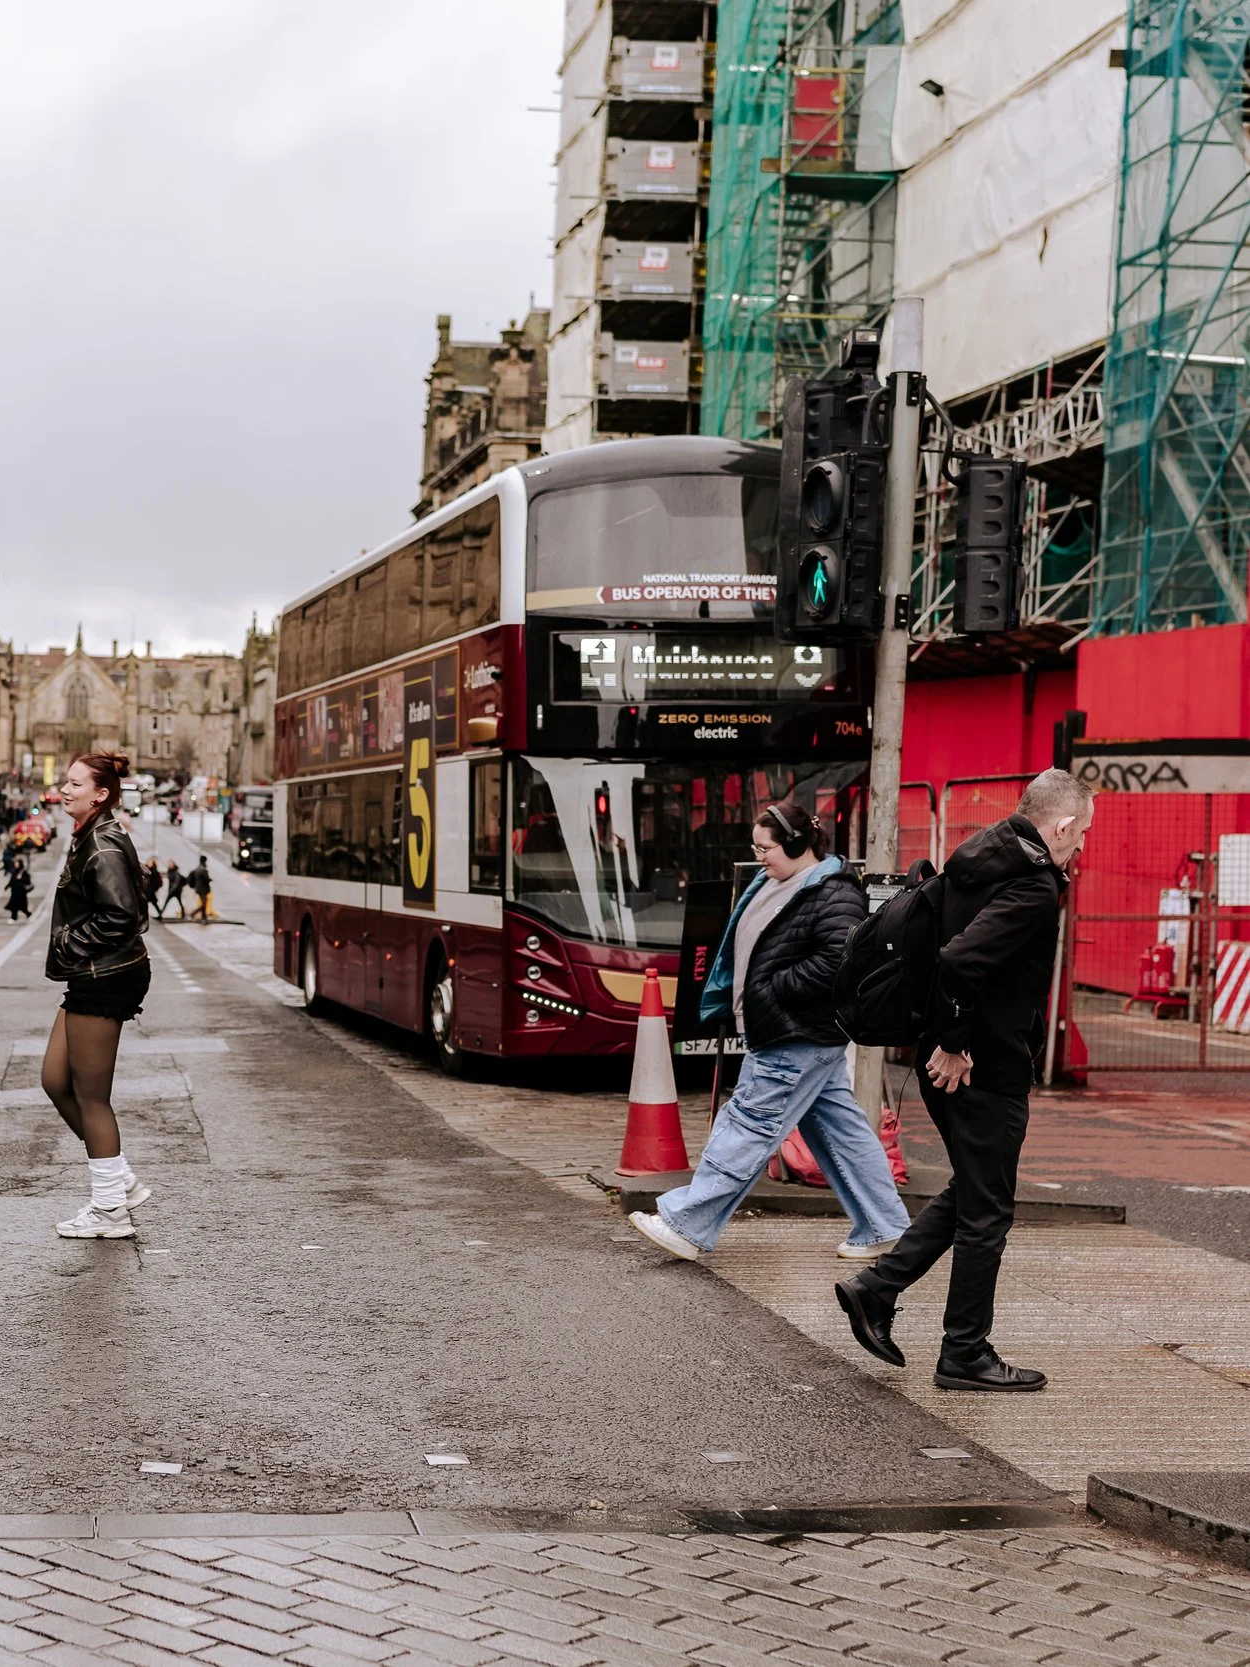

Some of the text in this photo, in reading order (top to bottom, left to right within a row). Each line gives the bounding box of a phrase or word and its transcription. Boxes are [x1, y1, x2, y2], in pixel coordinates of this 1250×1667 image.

[643, 573, 778, 585] NATIONAL TRANSPORT AWARDS
[612, 589, 642, 601] BUS
[643, 586, 720, 601] OPERATOR
[722, 586, 742, 600] OF
[743, 586, 771, 600] THE
[658, 714, 772, 724] ZERO EMISSION
[694, 726, 738, 739] electric
[835, 721, 863, 736] 704e
[408, 738, 431, 889] 5
